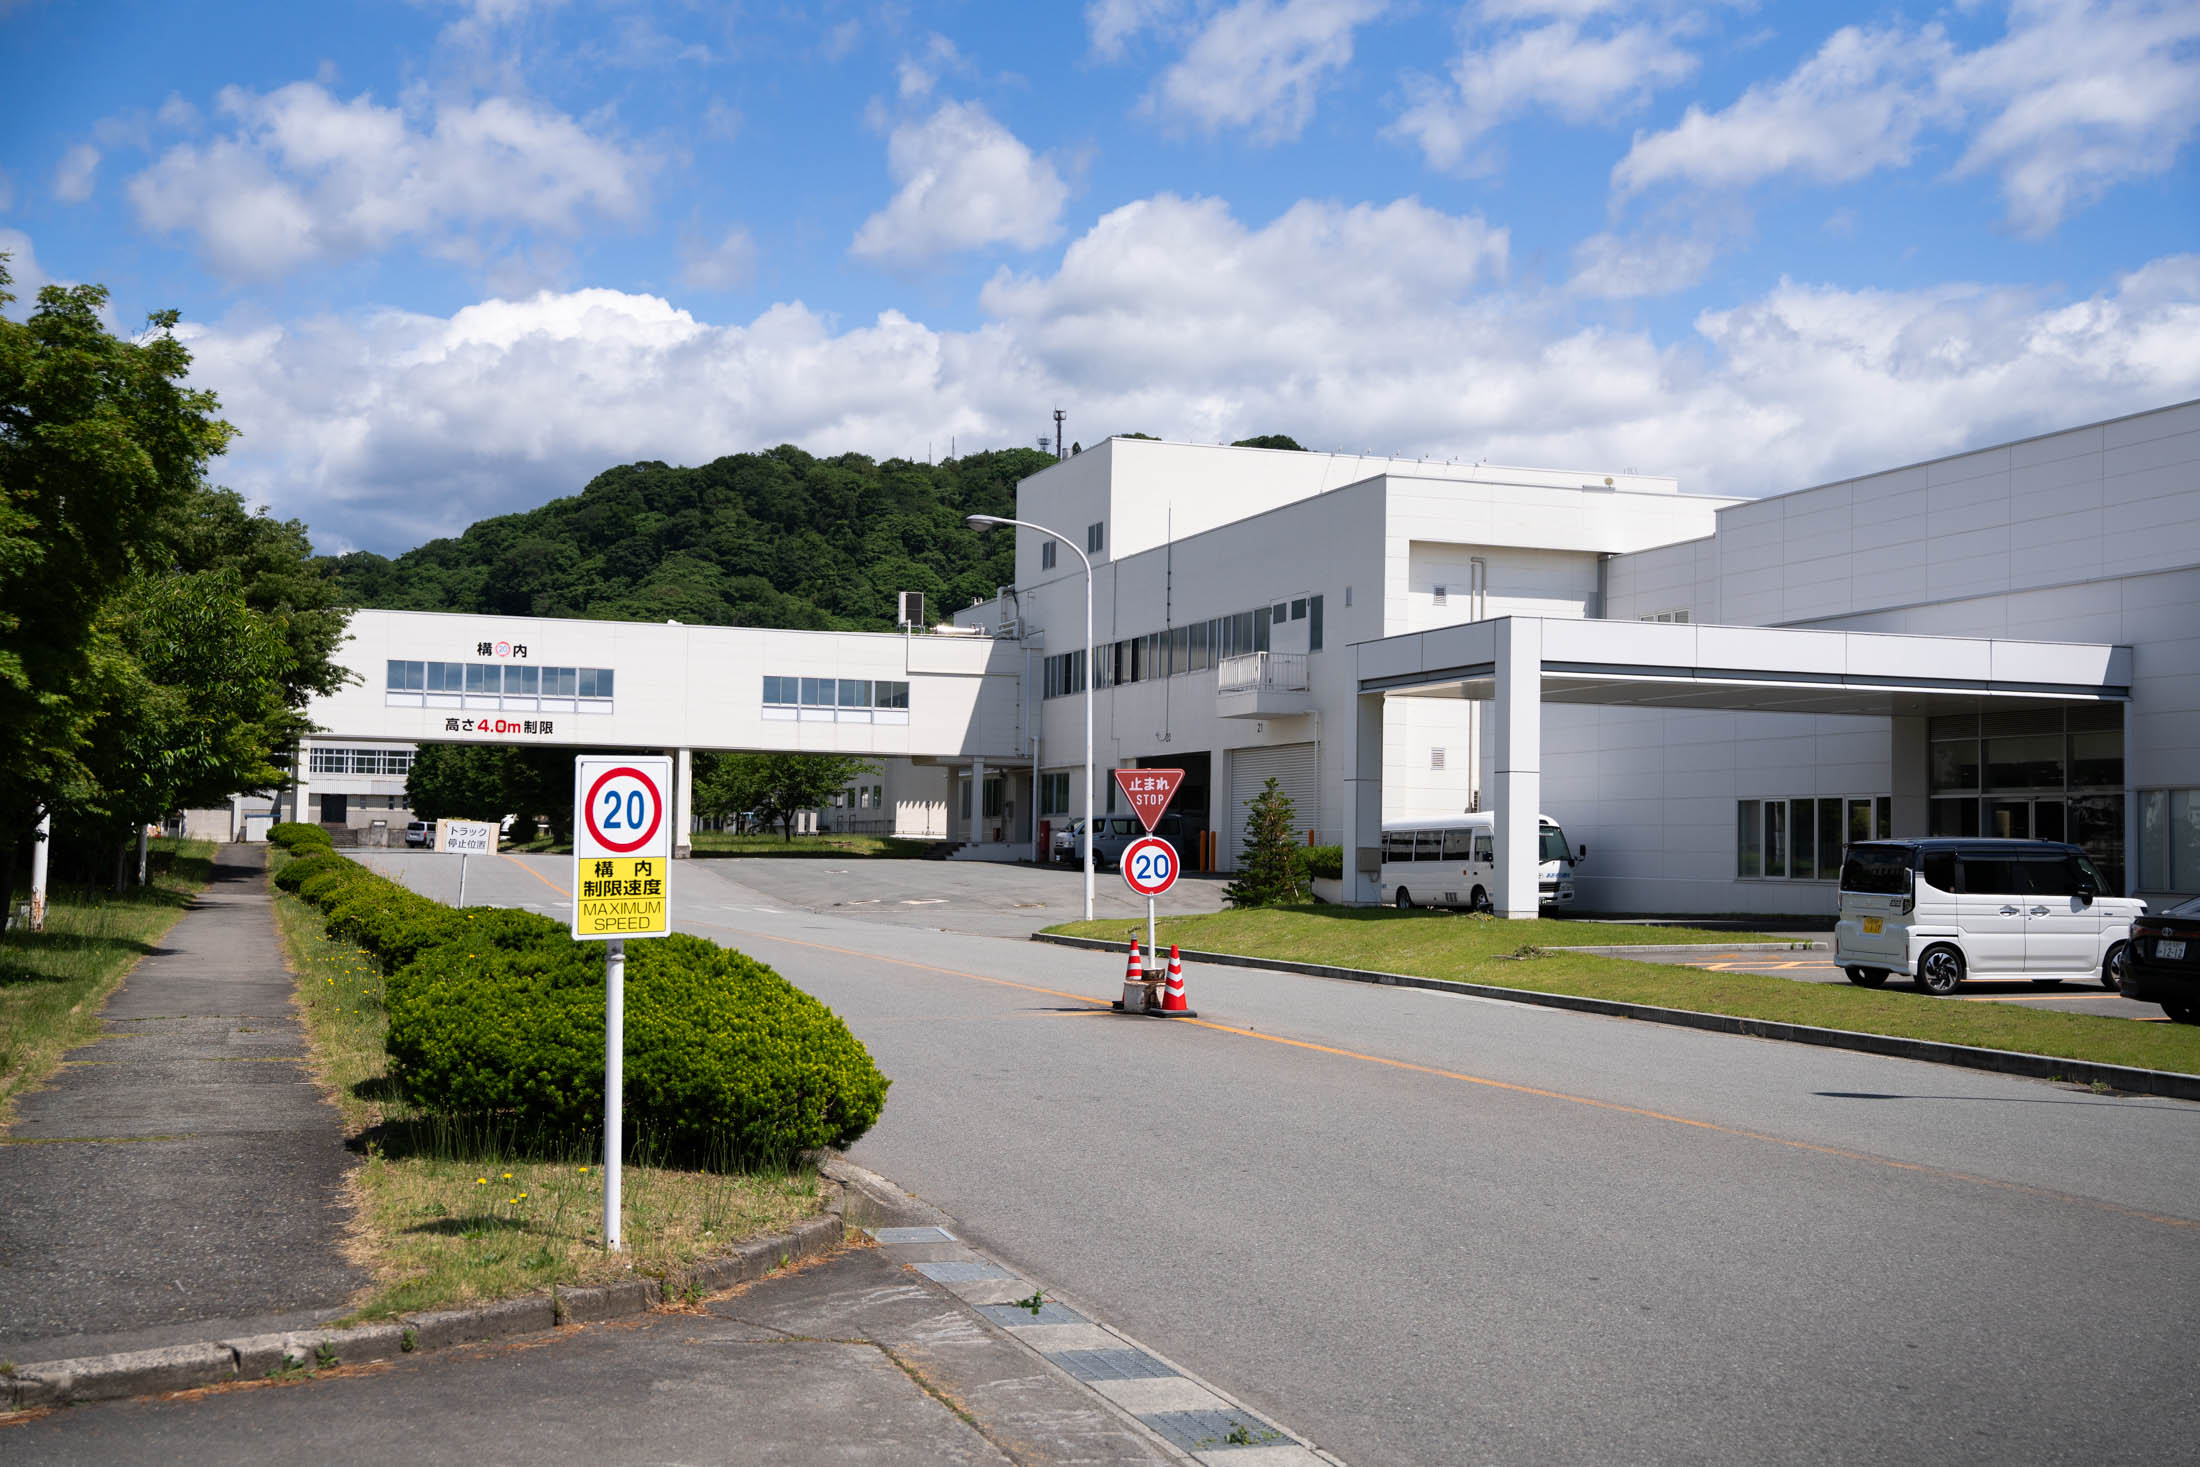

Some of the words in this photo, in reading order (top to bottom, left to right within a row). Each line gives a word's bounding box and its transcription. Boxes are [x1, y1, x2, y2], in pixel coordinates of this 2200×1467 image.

[1129, 777, 1170, 791] 止まれ
[1136, 794, 1164, 806] STOP
[603, 790, 645, 830] 20
[451, 826, 487, 837] トラック
[448, 838, 486, 849] 停止位置
[1136, 854, 1169, 879] 20
[584, 879, 661, 897] 制限速度
[583, 901, 661, 916] MAXIMUM
[594, 916, 650, 931] SPEED
